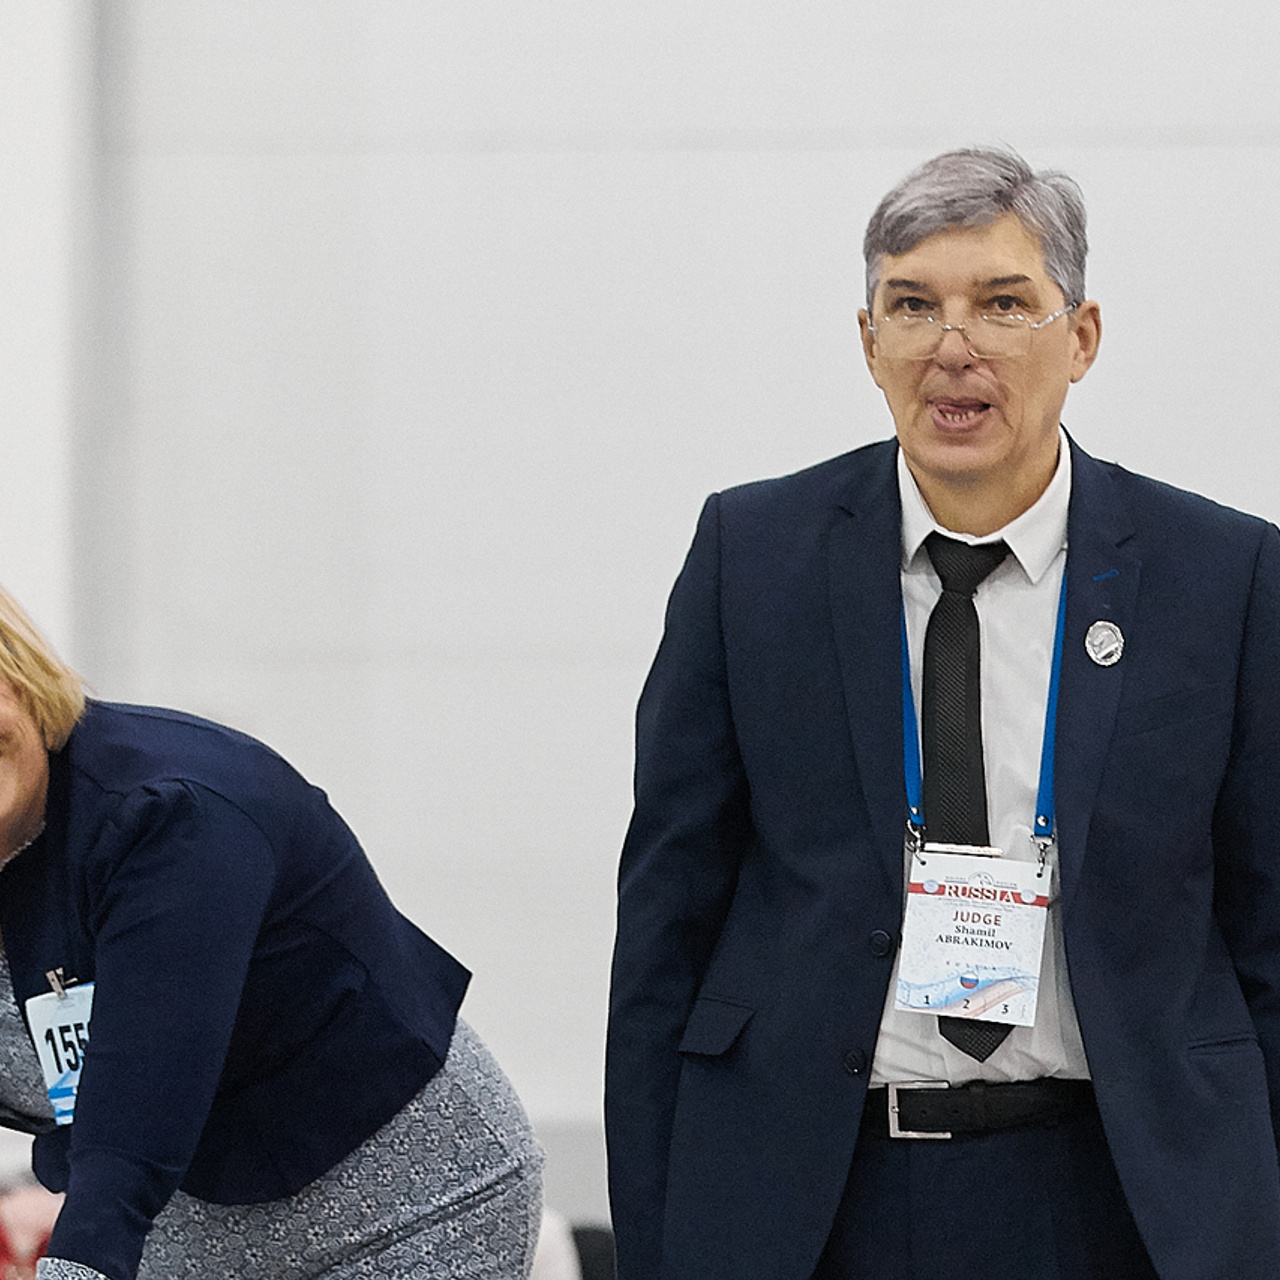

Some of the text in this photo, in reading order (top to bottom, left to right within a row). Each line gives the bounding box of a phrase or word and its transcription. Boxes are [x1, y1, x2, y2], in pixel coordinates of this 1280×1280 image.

[945, 884, 1016, 904] RUSSIA
[952, 910, 1002, 926] JUDGE
[954, 925, 996, 937] Shamil
[935, 934, 1013, 950] ABRAKIMOV
[924, 994, 1009, 1014] 1 2 3
